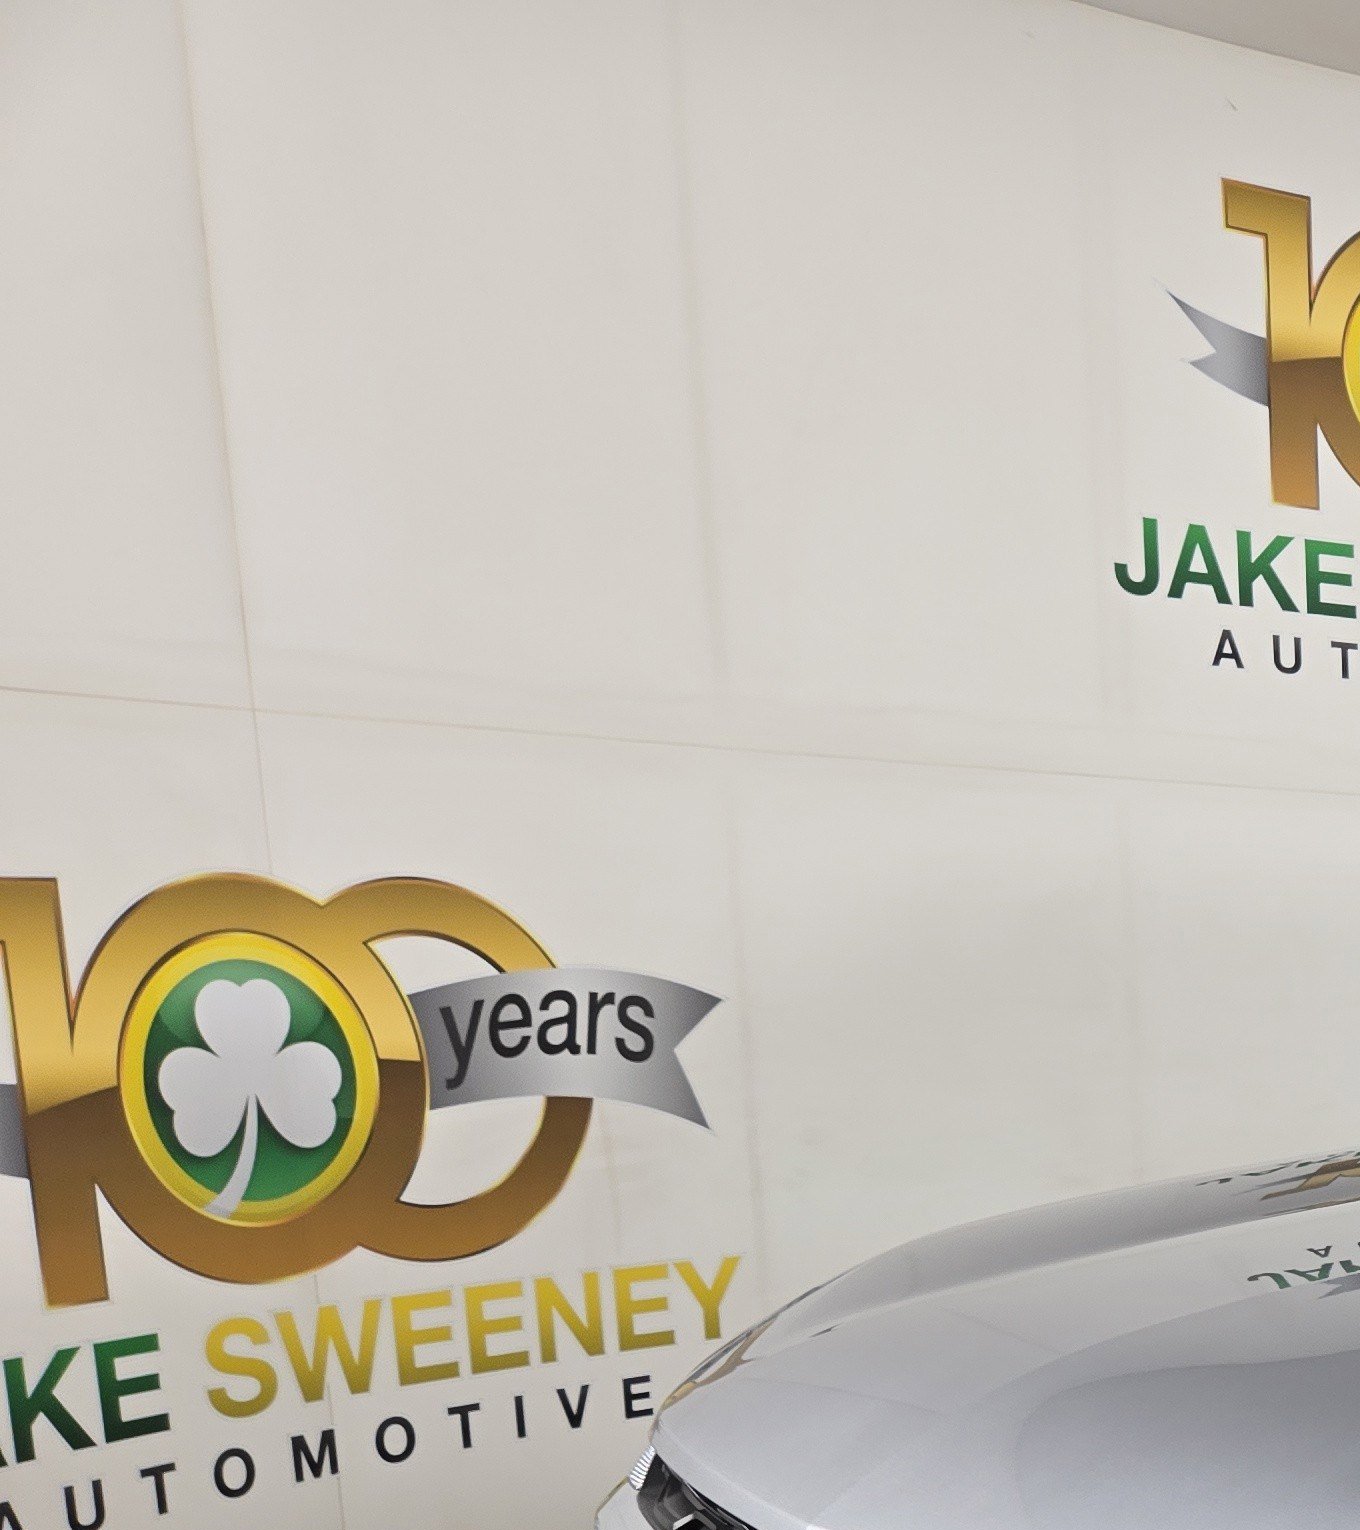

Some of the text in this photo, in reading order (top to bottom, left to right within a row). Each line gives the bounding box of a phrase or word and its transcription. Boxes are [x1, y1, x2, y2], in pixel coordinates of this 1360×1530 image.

[1113, 515, 1358, 620] JAKE
[439, 988, 657, 1090] years
[0, 1256, 742, 1469] KE SWEENEY
